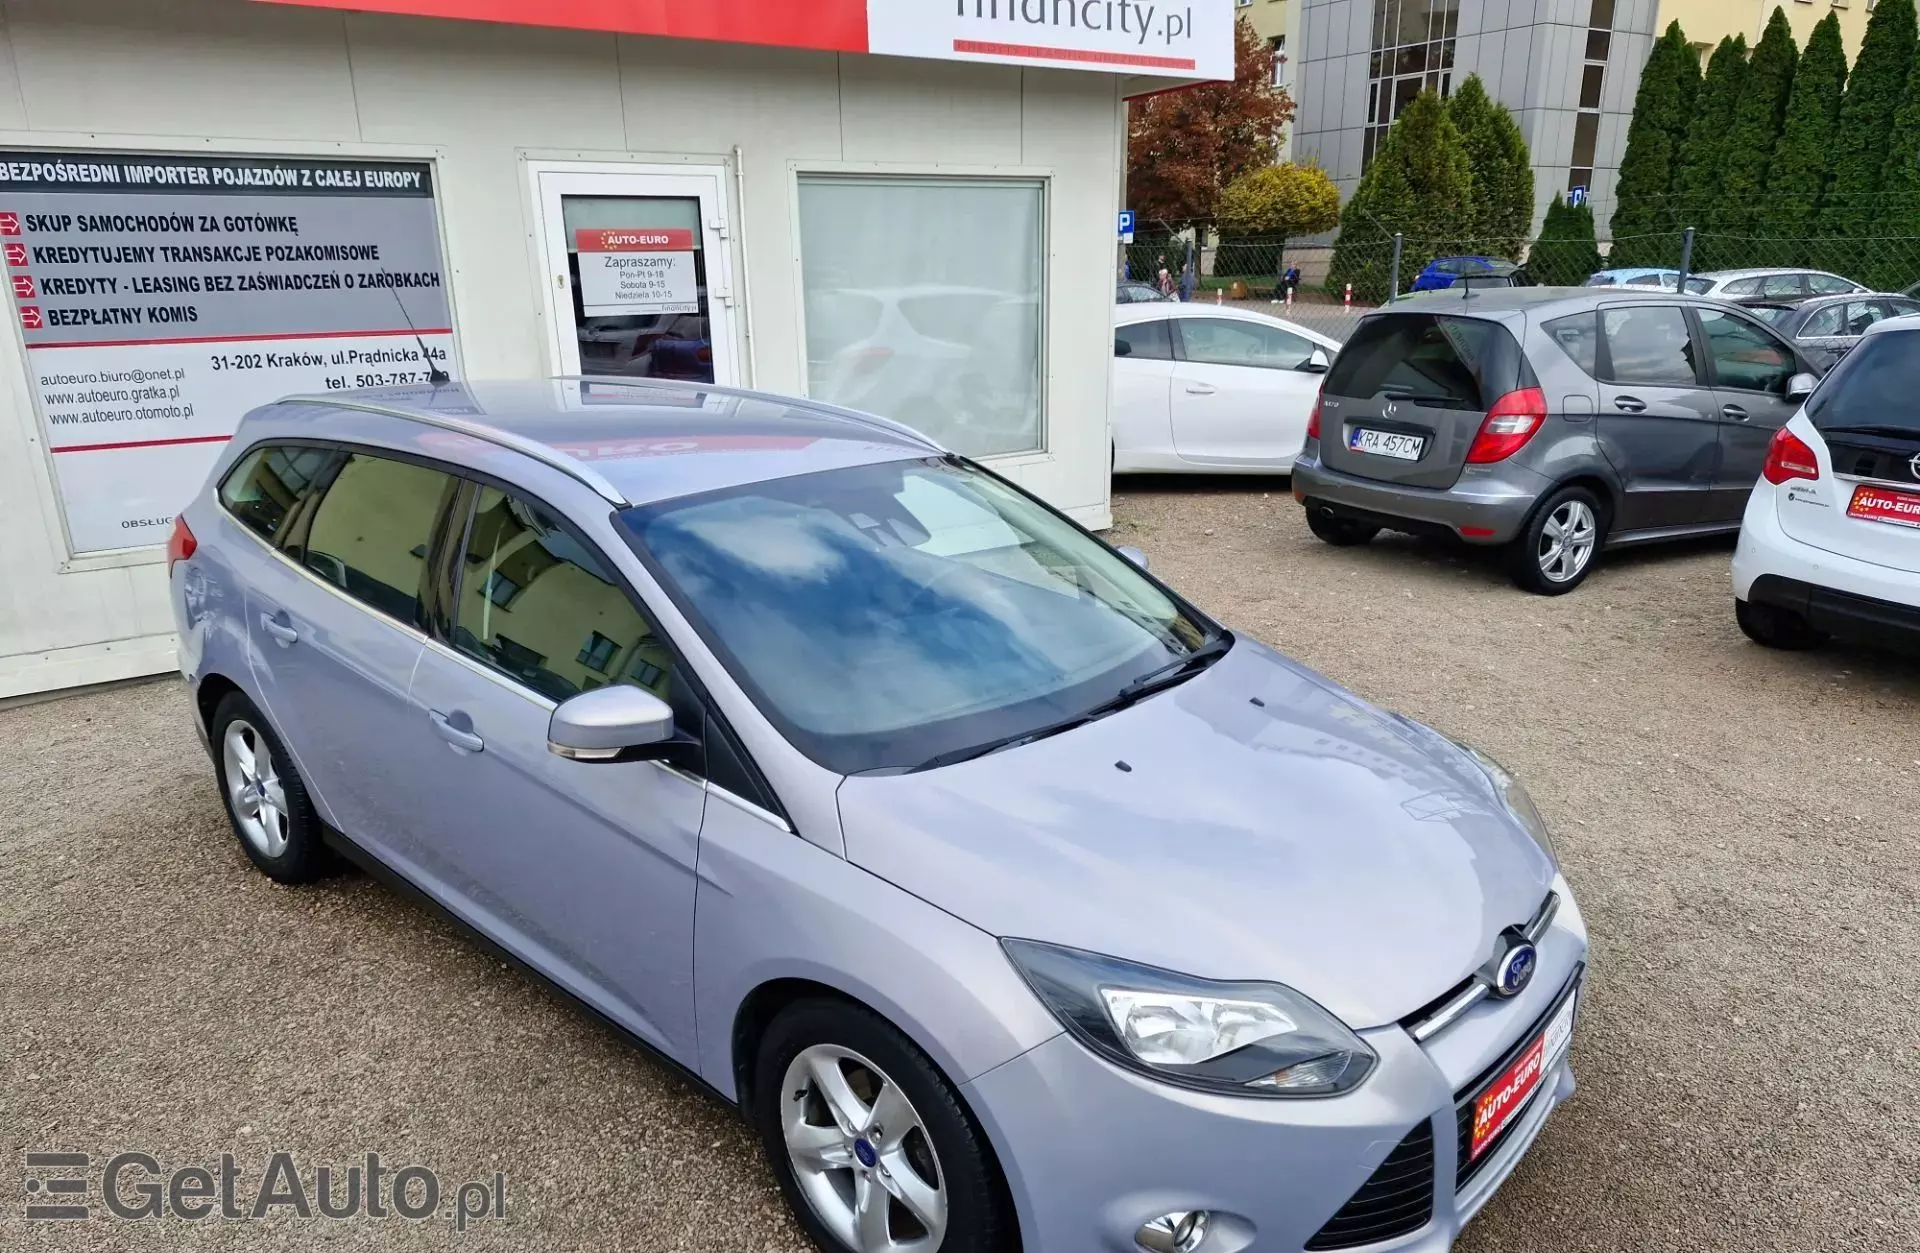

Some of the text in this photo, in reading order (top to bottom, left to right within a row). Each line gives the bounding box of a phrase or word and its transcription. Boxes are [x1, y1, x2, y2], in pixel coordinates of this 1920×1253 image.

[0, 159, 420, 188] BEZPOŚREDNI IMPORTER POJAZDÓW Z CAŁEJ EUROPY
[25, 211, 299, 236] SKUP SAMOCHODÓW ZA GOTÓWKĘ
[1119, 213, 1130, 231] P
[607, 235, 669, 245] AUTO-EURO
[32, 245, 380, 264] KREDYTUJEMY TRANSAKCJE POZAKOMISOWE
[604, 256, 676, 270] Zapraszamy:
[40, 277, 117, 295] KREDYTY
[132, 276, 200, 293] LEASING
[204, 275, 234, 292] BEZ
[237, 270, 341, 291] ZAŚWIADCZEŃ
[344, 274, 353, 289] O
[358, 272, 440, 288] ZAROBKACH
[620, 281, 647, 289] Sobota
[47, 306, 198, 326] BEZPŁATNY KOMIS
[211, 354, 263, 370] 31-202
[266, 352, 328, 368] Kraków,
[331, 348, 419, 367] ul.Prądnicka
[41, 368, 185, 386] autoeuro.biuro@onet.pl
[325, 376, 351, 389] tel.
[45, 385, 180, 405] www.autoeuro.gratka.pl
[49, 403, 194, 425] www.autoeuro.otomoto.pl
[1359, 431, 1421, 455] KRA 457CM
[1478, 1051, 1541, 1127] AUTO-EURO
